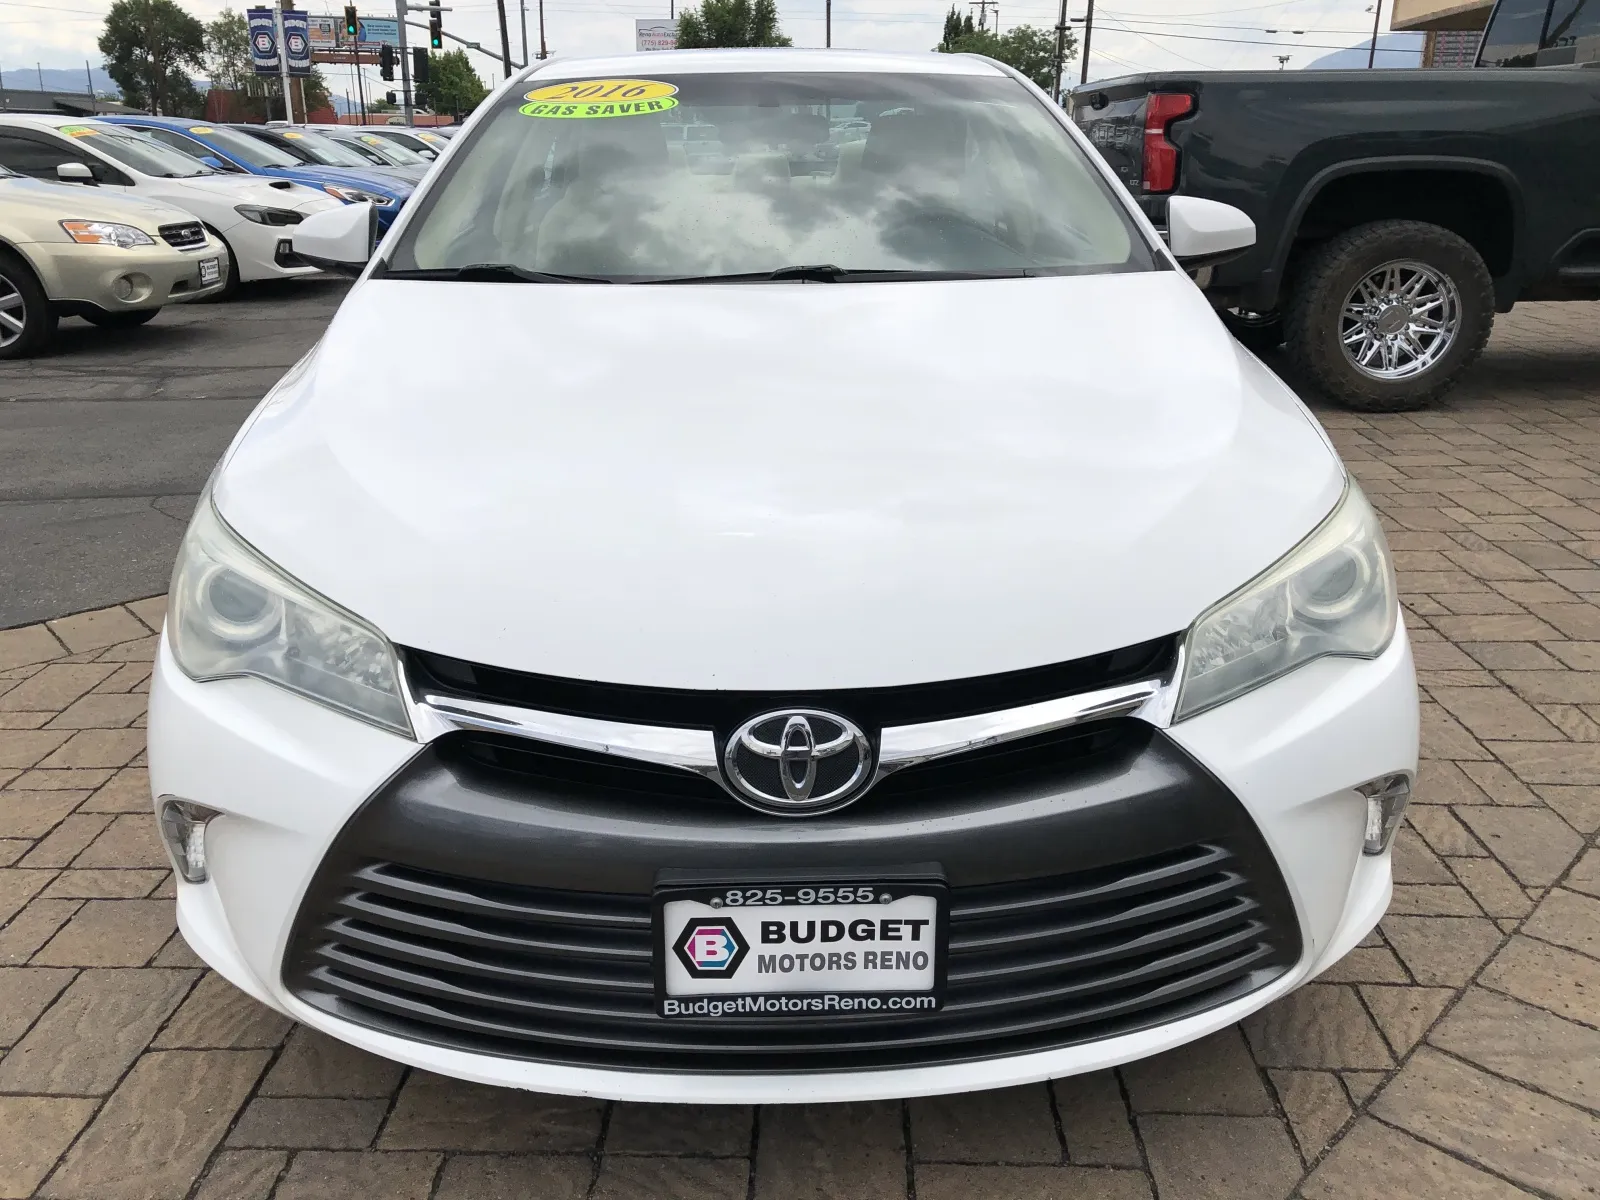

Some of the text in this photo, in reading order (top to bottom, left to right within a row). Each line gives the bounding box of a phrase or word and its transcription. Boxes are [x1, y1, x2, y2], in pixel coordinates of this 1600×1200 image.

[545, 84, 653, 100] 2016
[530, 101, 663, 116] GAS SAVER
[725, 887, 875, 906] 825-9555
[760, 919, 929, 944] BUDGET
[694, 934, 729, 962] B
[757, 950, 929, 974] MOTORS RENO
[663, 994, 936, 1017] BudgetMotorsReno.com
